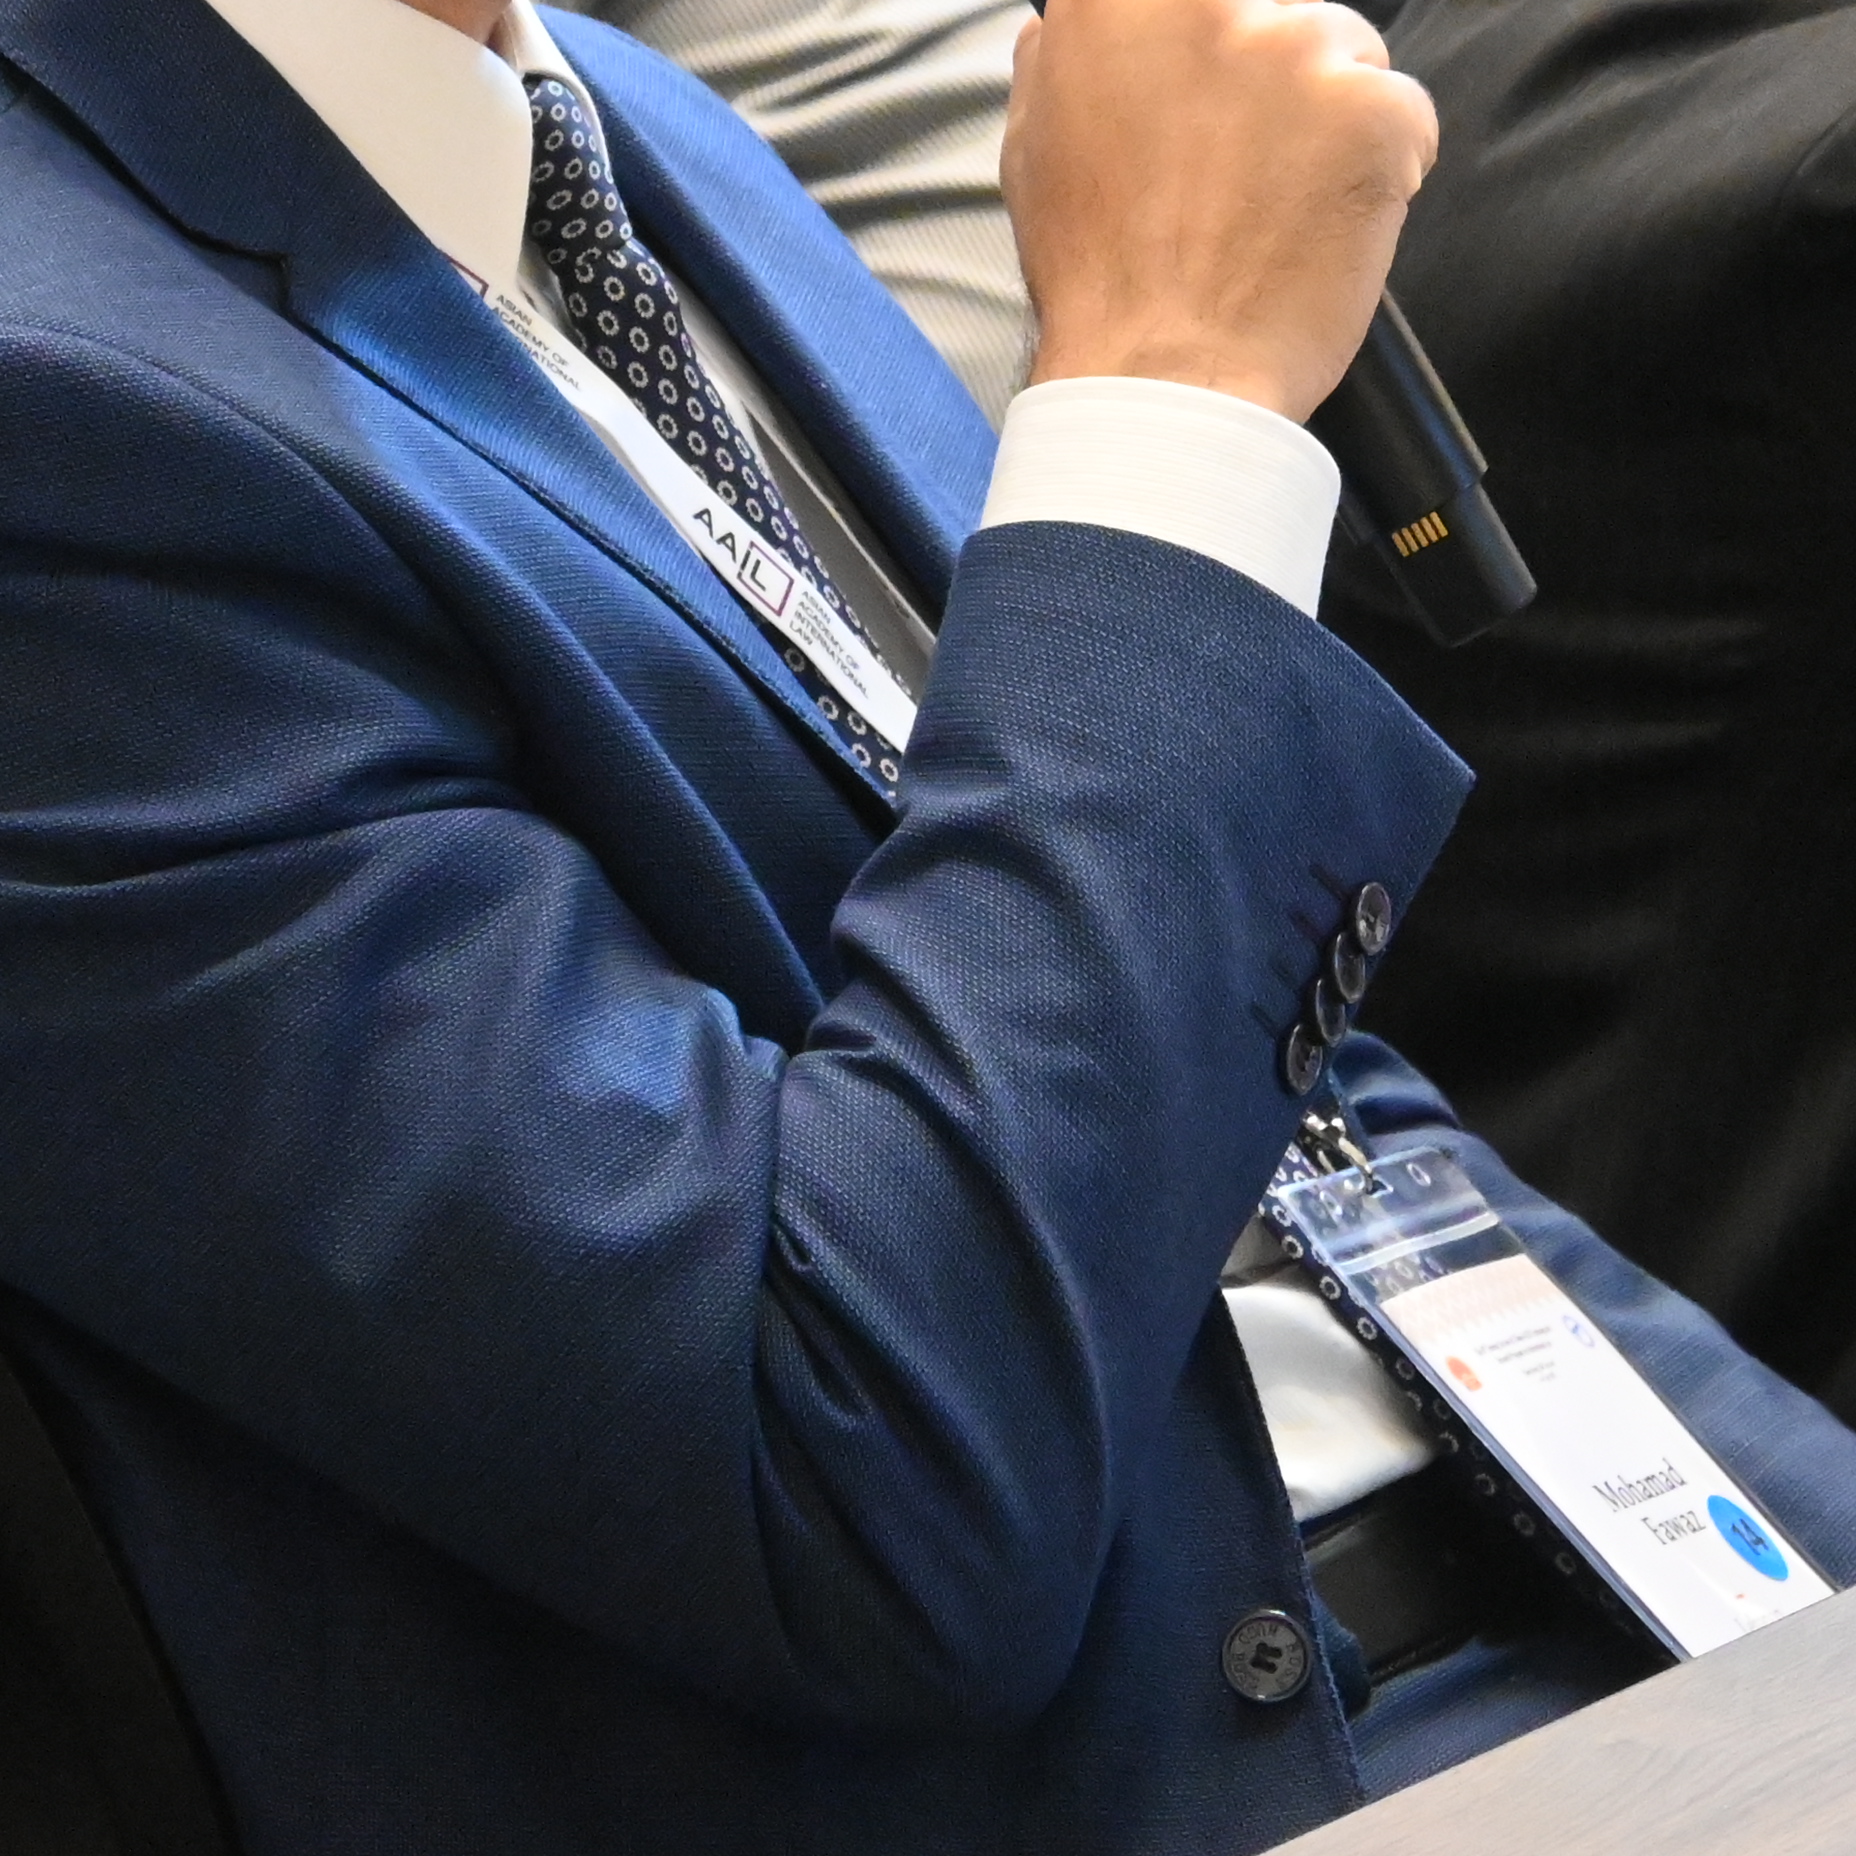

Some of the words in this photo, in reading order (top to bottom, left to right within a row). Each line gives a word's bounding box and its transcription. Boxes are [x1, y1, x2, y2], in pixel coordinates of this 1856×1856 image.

[492, 306, 550, 352] ACADEMY
[552, 352, 568, 367] OF
[496, 294, 533, 326] ASIAN
[521, 339, 582, 392] NATIONAL
[692, 507, 768, 593] AAIL
[789, 621, 813, 646] LAW
[797, 601, 844, 653] ACADEMY
[845, 654, 860, 670] OF
[802, 591, 832, 625] ASIAN
[795, 610, 869, 699] INTERNATIONAL
[1592, 1456, 1688, 1513] Mohamad
[1640, 1510, 1707, 1546] Fawaz
